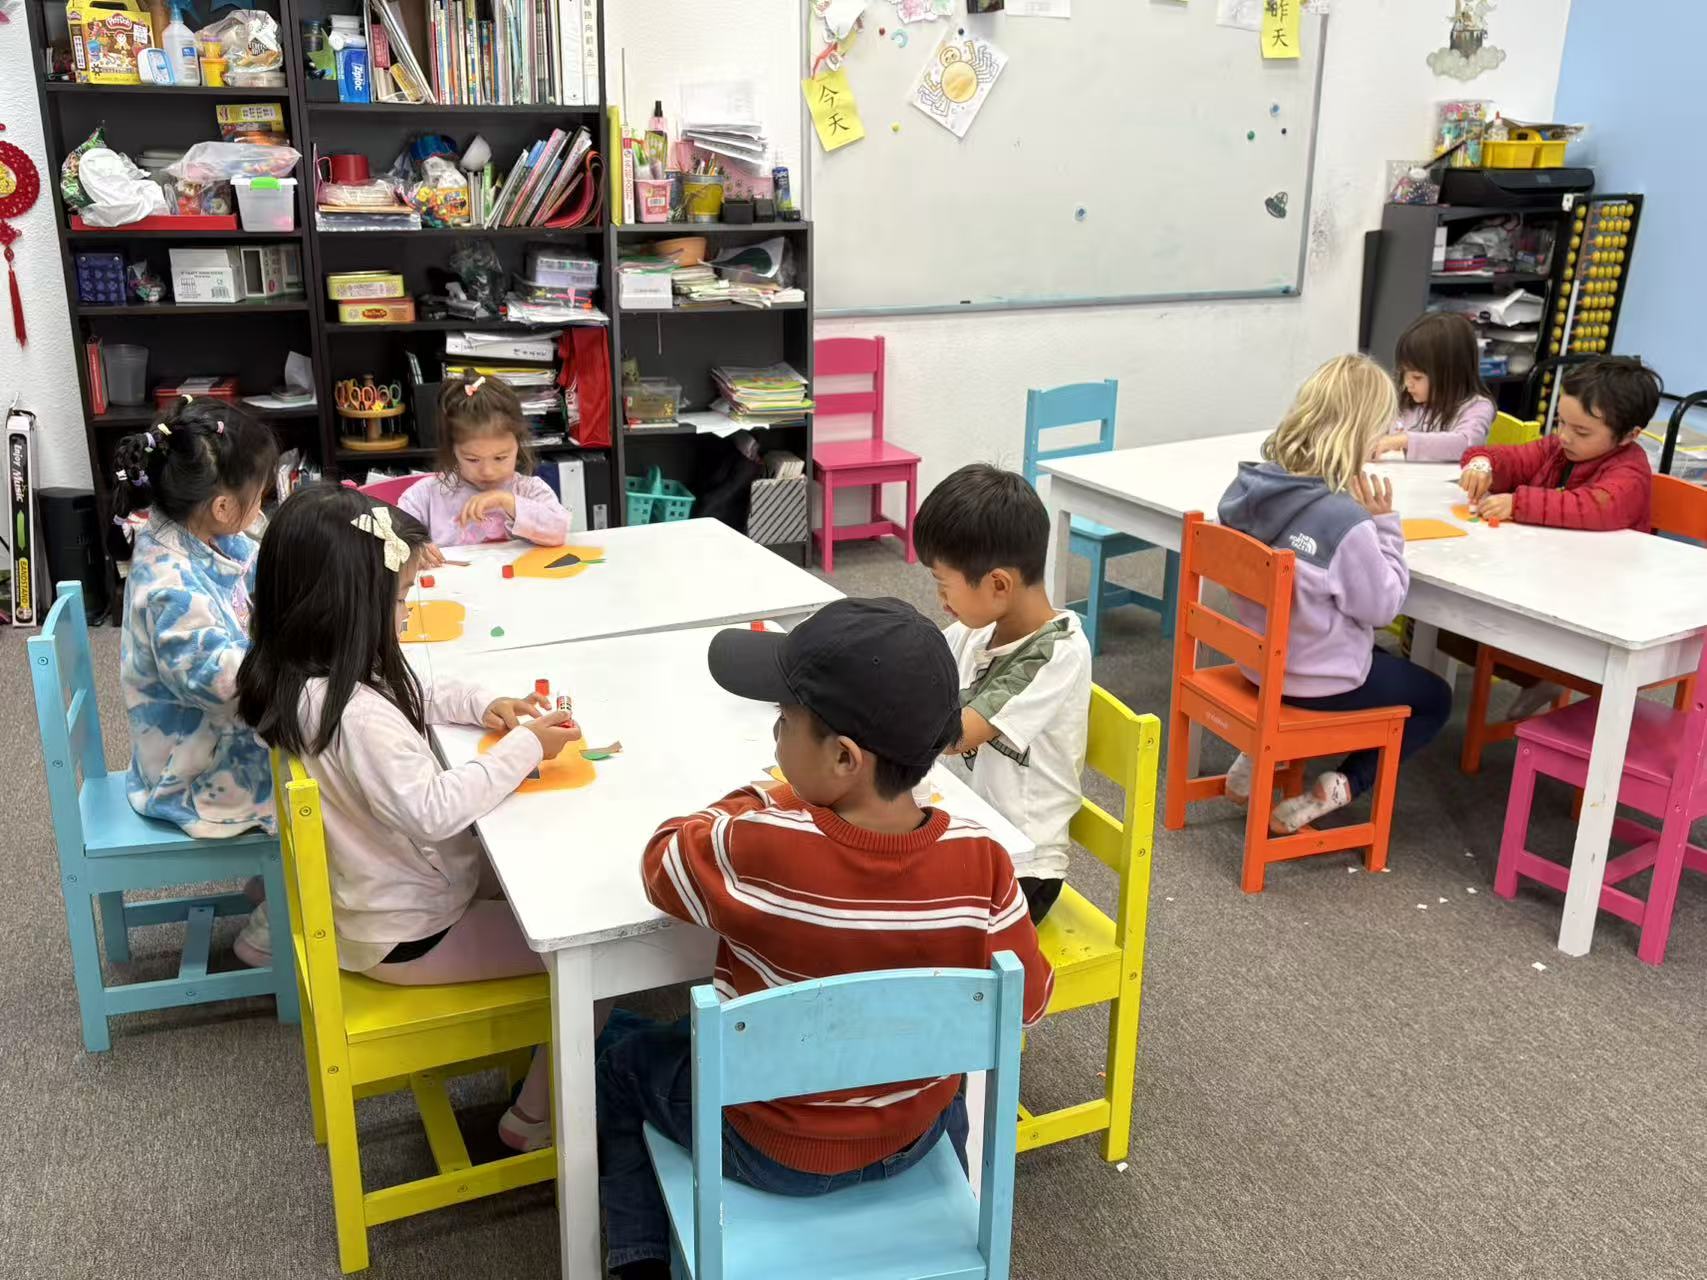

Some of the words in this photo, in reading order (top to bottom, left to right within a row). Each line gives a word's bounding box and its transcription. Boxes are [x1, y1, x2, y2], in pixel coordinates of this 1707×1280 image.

[352, 63, 364, 91] Ziploc
[819, 85, 850, 137] 今天
[13, 444, 23, 467] Enjoy
[12, 468, 25, 503] Music
